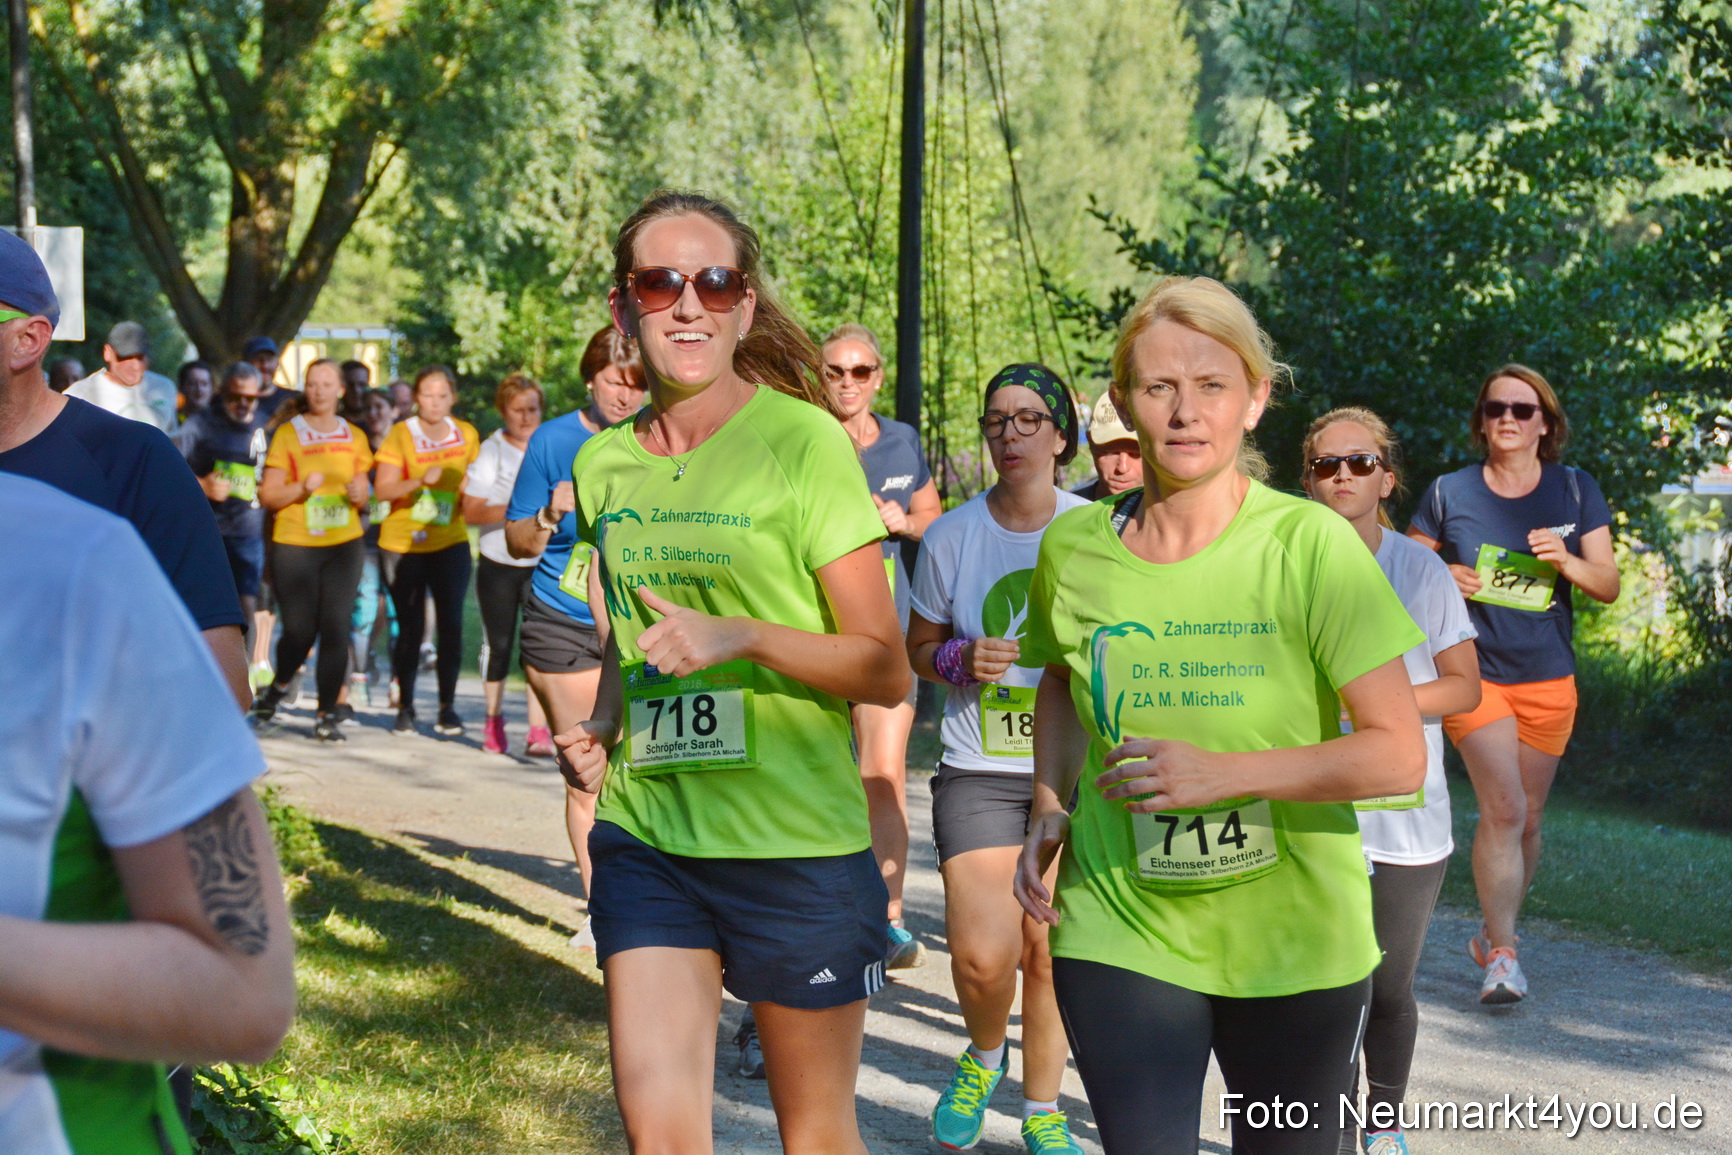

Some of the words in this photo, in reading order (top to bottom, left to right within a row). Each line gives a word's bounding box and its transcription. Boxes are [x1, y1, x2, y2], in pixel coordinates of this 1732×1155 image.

[651, 508, 751, 528] Zahnarztpraxis
[623, 548, 640, 562] Dr.
[644, 546, 657, 561] R.
[661, 546, 731, 565] Silberhorn
[627, 574, 647, 589] ZA
[648, 573, 666, 586] M.
[1492, 569, 1537, 594] 877
[1132, 664, 1153, 679] Dr.
[1159, 662, 1174, 678] R.
[1180, 661, 1265, 677] Silberhorn
[1132, 692, 1154, 708] ZA
[1159, 691, 1176, 707] M.
[1181, 691, 1245, 706] Michalk
[646, 694, 718, 741] 718
[1001, 712, 1034, 737] 18
[646, 741, 688, 755] Schröpfer
[690, 738, 724, 750] Sarah
[722, 748, 745, 756] Michalk
[1154, 810, 1249, 856] 714
[1139, 867, 1199, 877] Gemeinschaftspraxis
[1211, 863, 1245, 874] Silberhorn
[1245, 860, 1255, 868] ZA
[1255, 853, 1277, 864] Michalk
[1150, 857, 1216, 870] Eichenseer
[1220, 848, 1263, 866] Bettina
